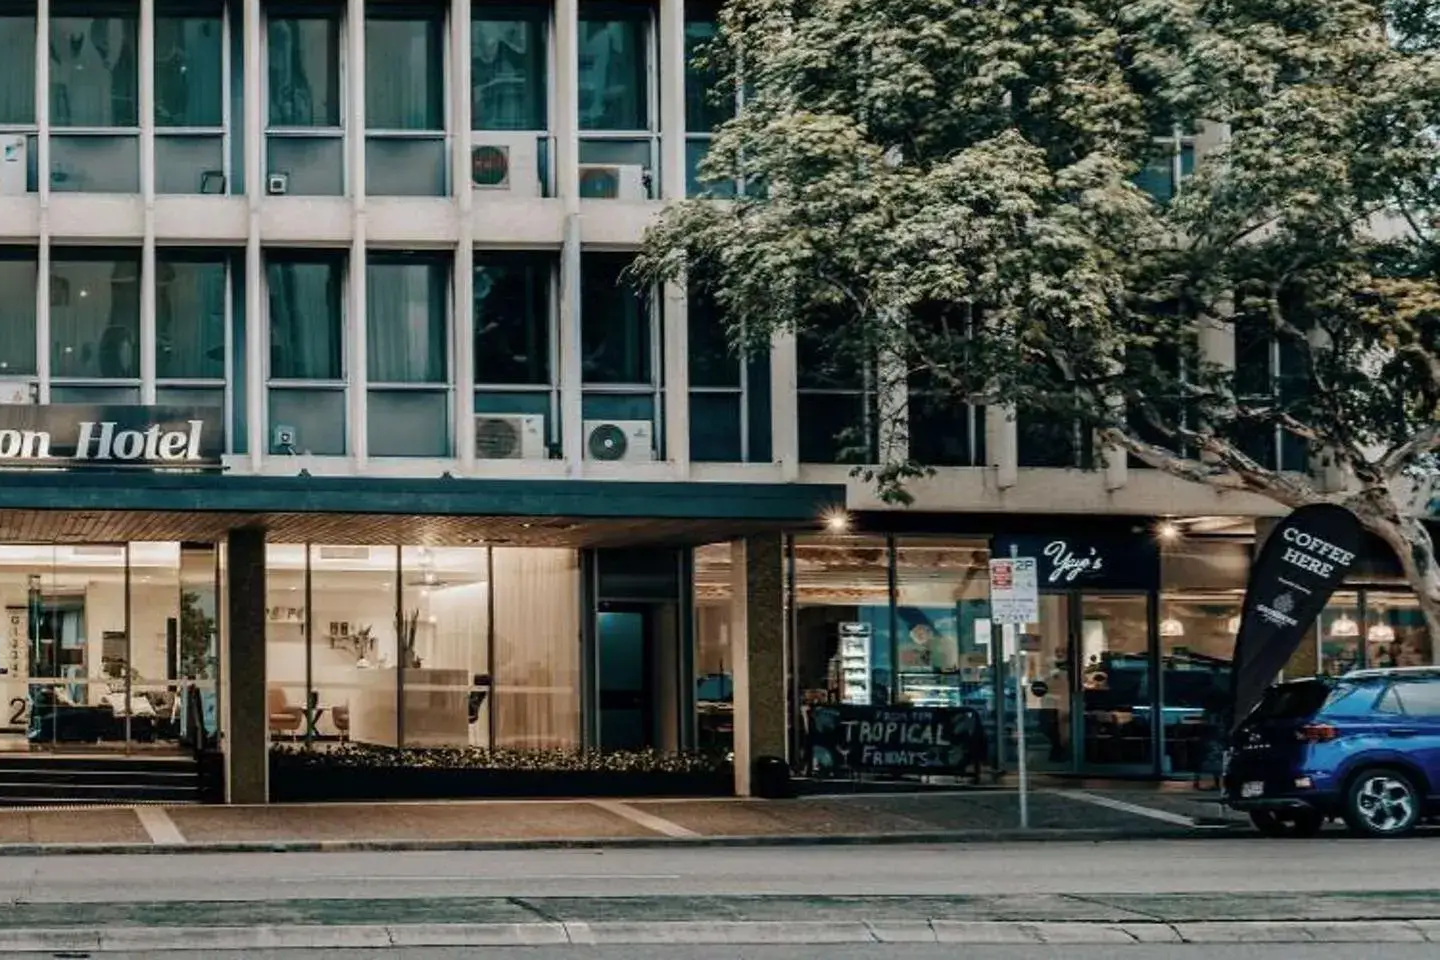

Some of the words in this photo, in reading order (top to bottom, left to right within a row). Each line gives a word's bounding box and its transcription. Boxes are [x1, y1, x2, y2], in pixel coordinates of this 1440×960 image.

[74, 419, 202, 461] Hotel
[1280, 547, 1335, 579] HERE
[1282, 527, 1357, 566] COFFEE
[839, 720, 951, 746] TROPICAL
